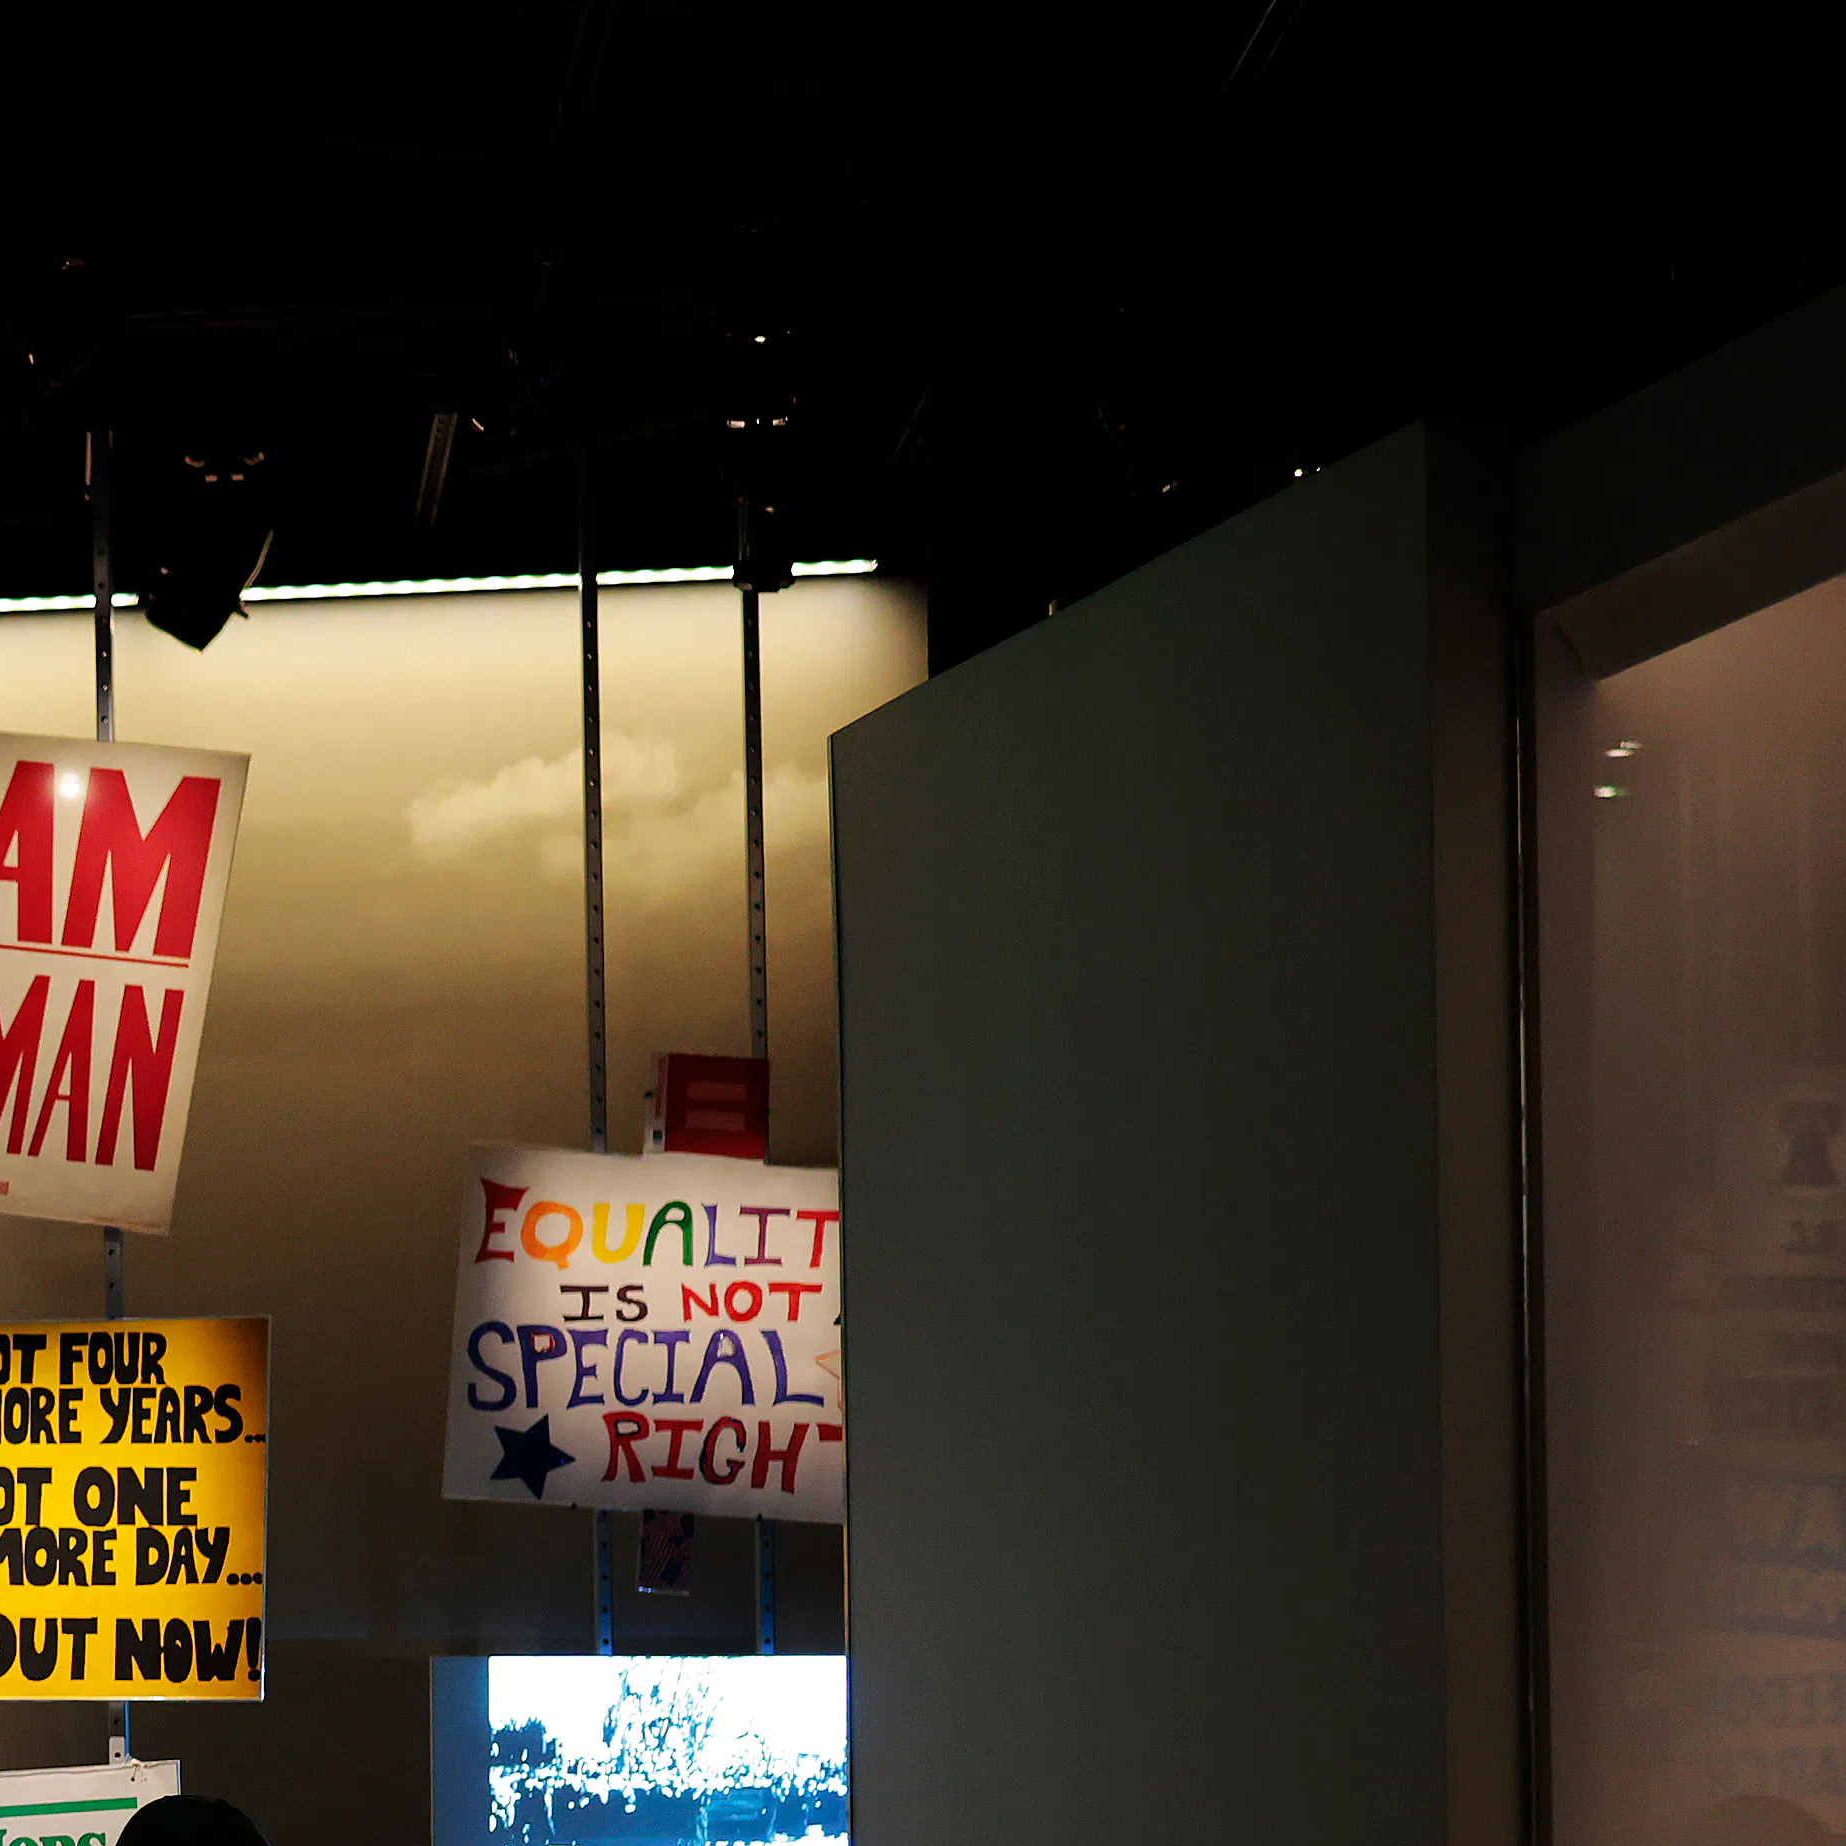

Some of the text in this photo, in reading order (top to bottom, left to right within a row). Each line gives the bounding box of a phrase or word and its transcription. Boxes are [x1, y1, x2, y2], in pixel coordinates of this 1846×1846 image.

[560, 1281, 822, 1322] IS NOT
[58, 1332, 167, 1386] FOUR
[467, 1320, 824, 1413] SPECIAL
[99, 1384, 266, 1445] YEARS...
[74, 1466, 198, 1527] ONE
[134, 1526, 263, 1587] DAY...
[114, 1617, 262, 1683] NOW!
